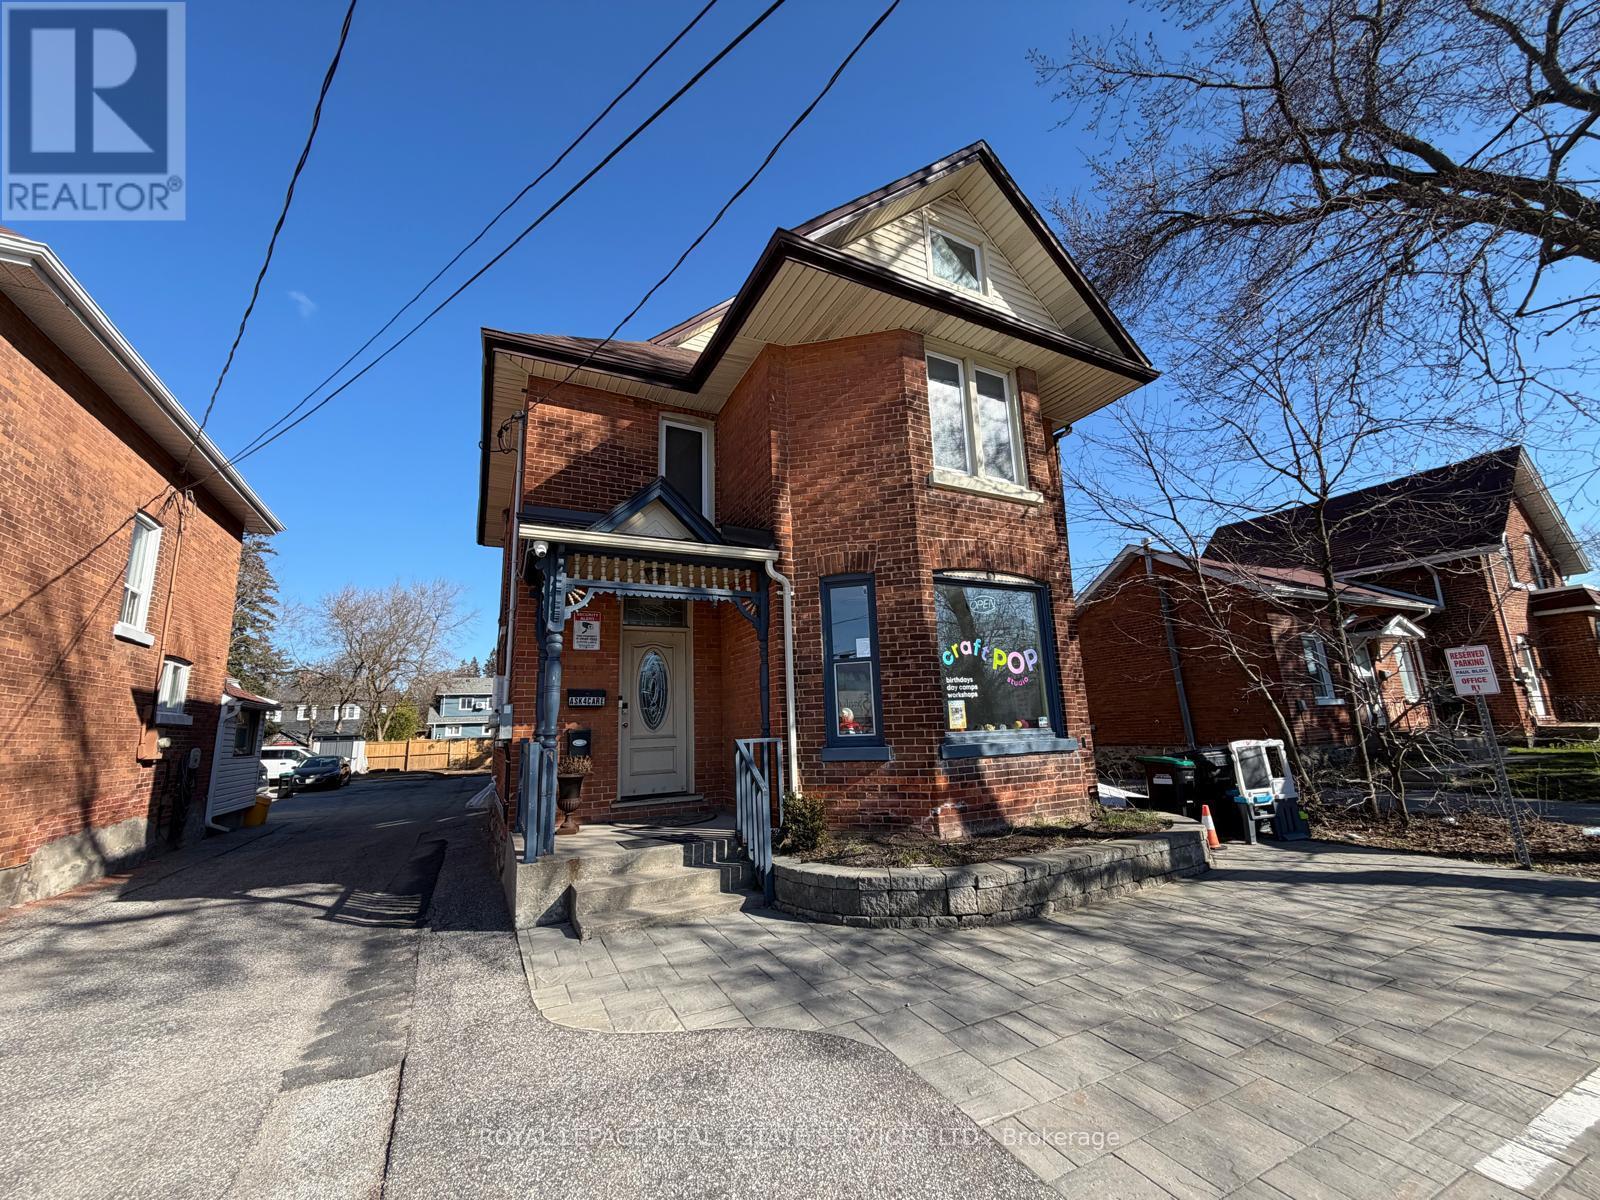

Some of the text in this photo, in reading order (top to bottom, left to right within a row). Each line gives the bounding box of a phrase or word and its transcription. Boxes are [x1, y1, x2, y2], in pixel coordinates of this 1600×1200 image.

[970, 598, 996, 610] OPEN
[1449, 650, 1485, 660] RESERVED
[992, 648, 1038, 675] POP
[1454, 658, 1485, 667] PARKING
[945, 676, 973, 684] birthdays
[1007, 676, 1029, 687] studio
[947, 691, 979, 699] workshops
